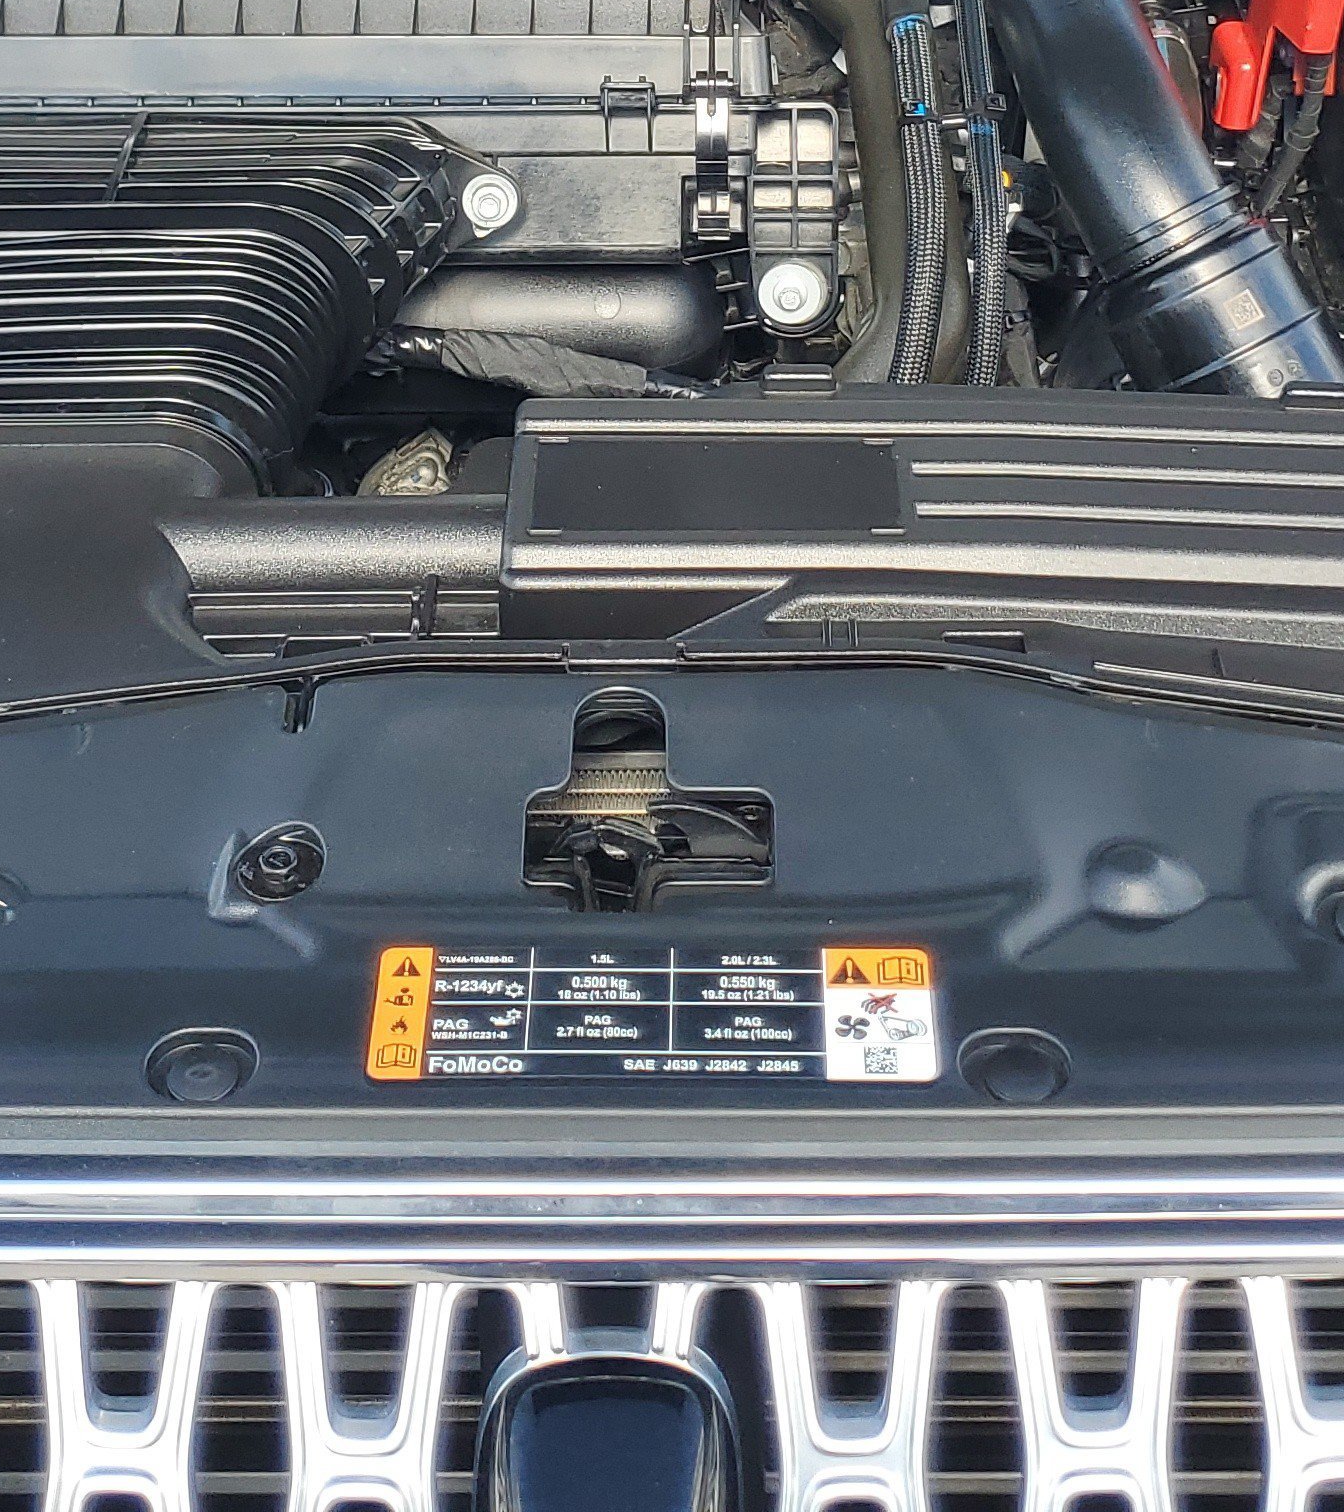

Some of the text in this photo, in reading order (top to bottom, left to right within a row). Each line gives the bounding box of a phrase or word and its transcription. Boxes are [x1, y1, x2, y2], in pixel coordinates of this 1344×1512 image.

[590, 954, 614, 964] 1.5L
[721, 955, 744, 965] 2.0L
[752, 955, 777, 965] 2.3L
[434, 979, 505, 994] R-1234yf
[571, 976, 628, 991] 0.500 kg
[719, 976, 776, 991] 0.550 kg
[574, 992, 588, 1000] oz
[590, 990, 616, 1001] (1.10
[619, 990, 641, 1001] lbs)
[702, 990, 795, 1001] 19.5 oz (1.21 lbs)
[433, 1019, 469, 1030] PAG
[584, 1015, 612, 1025] PAG
[734, 1016, 763, 1026] PAG
[556, 1027, 638, 1039] 2.7 fl oz (80cc)
[704, 1029, 793, 1040] 3.4 fl oz (100cc)
[428, 1056, 524, 1073] FoMoCo
[623, 1059, 656, 1071] SAE
[662, 1059, 698, 1071] J639
[704, 1060, 748, 1071] J2842
